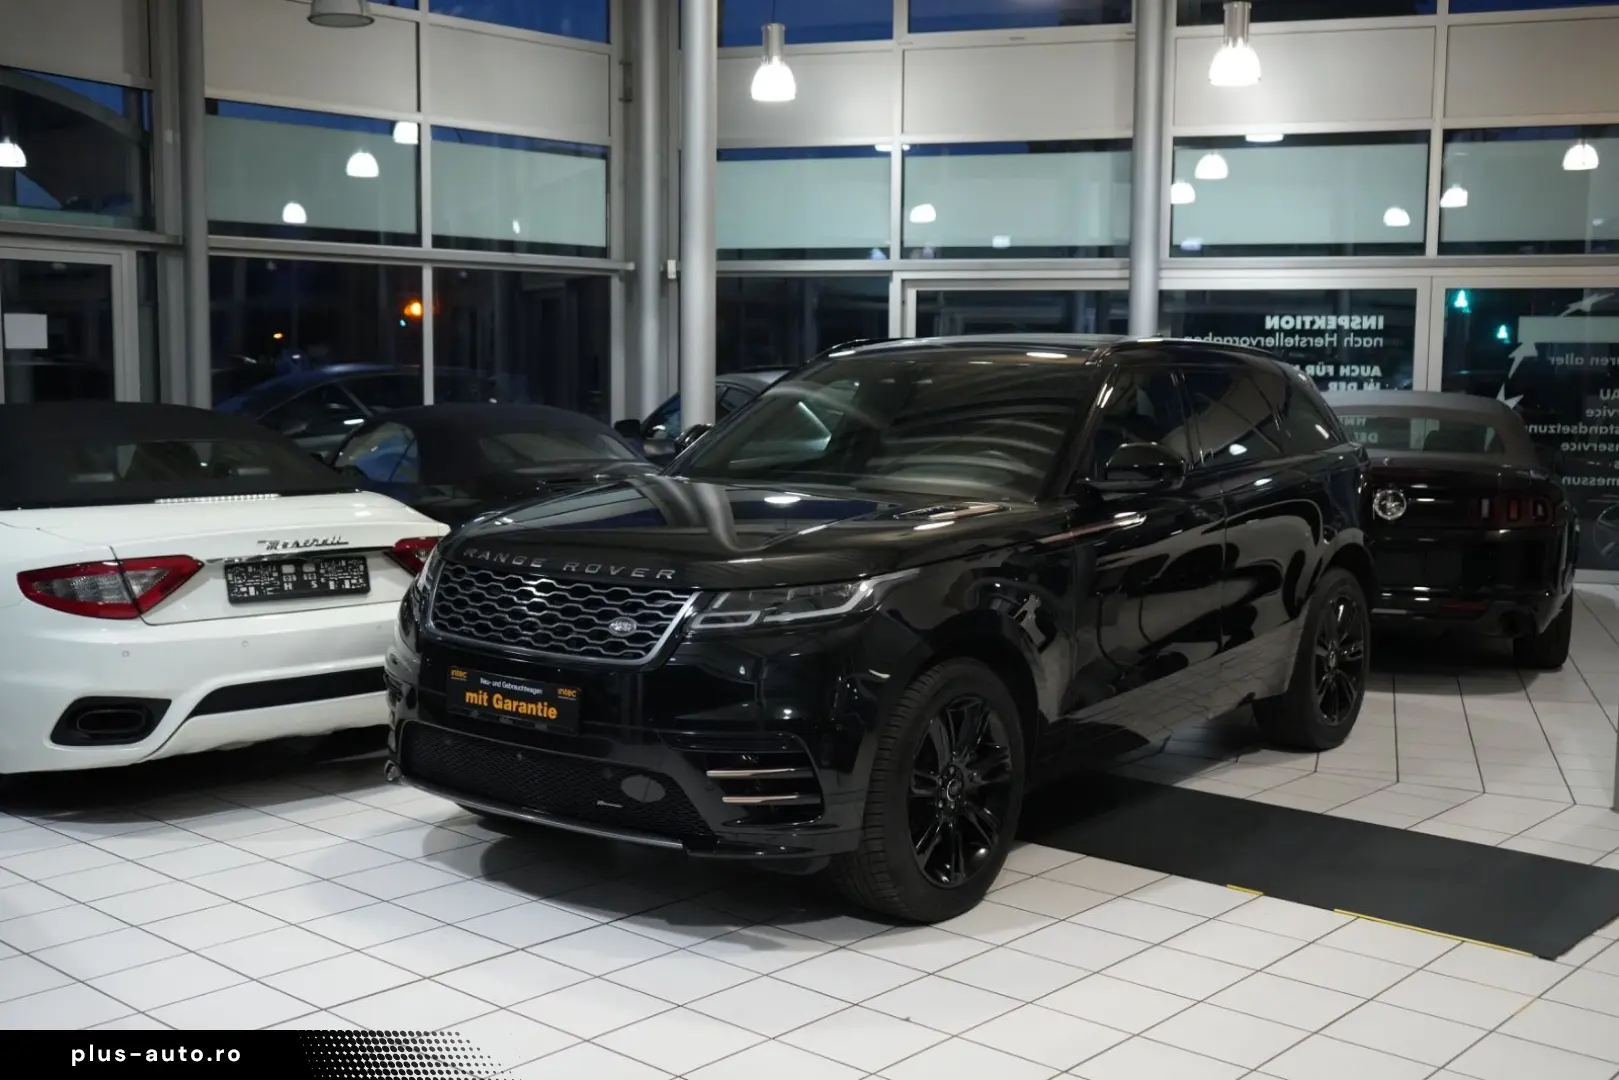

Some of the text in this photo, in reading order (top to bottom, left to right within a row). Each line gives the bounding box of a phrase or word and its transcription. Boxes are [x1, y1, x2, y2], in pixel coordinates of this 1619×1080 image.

[463, 548, 676, 580] RANGE ROVER
[464, 689, 559, 720] mit Garantie
